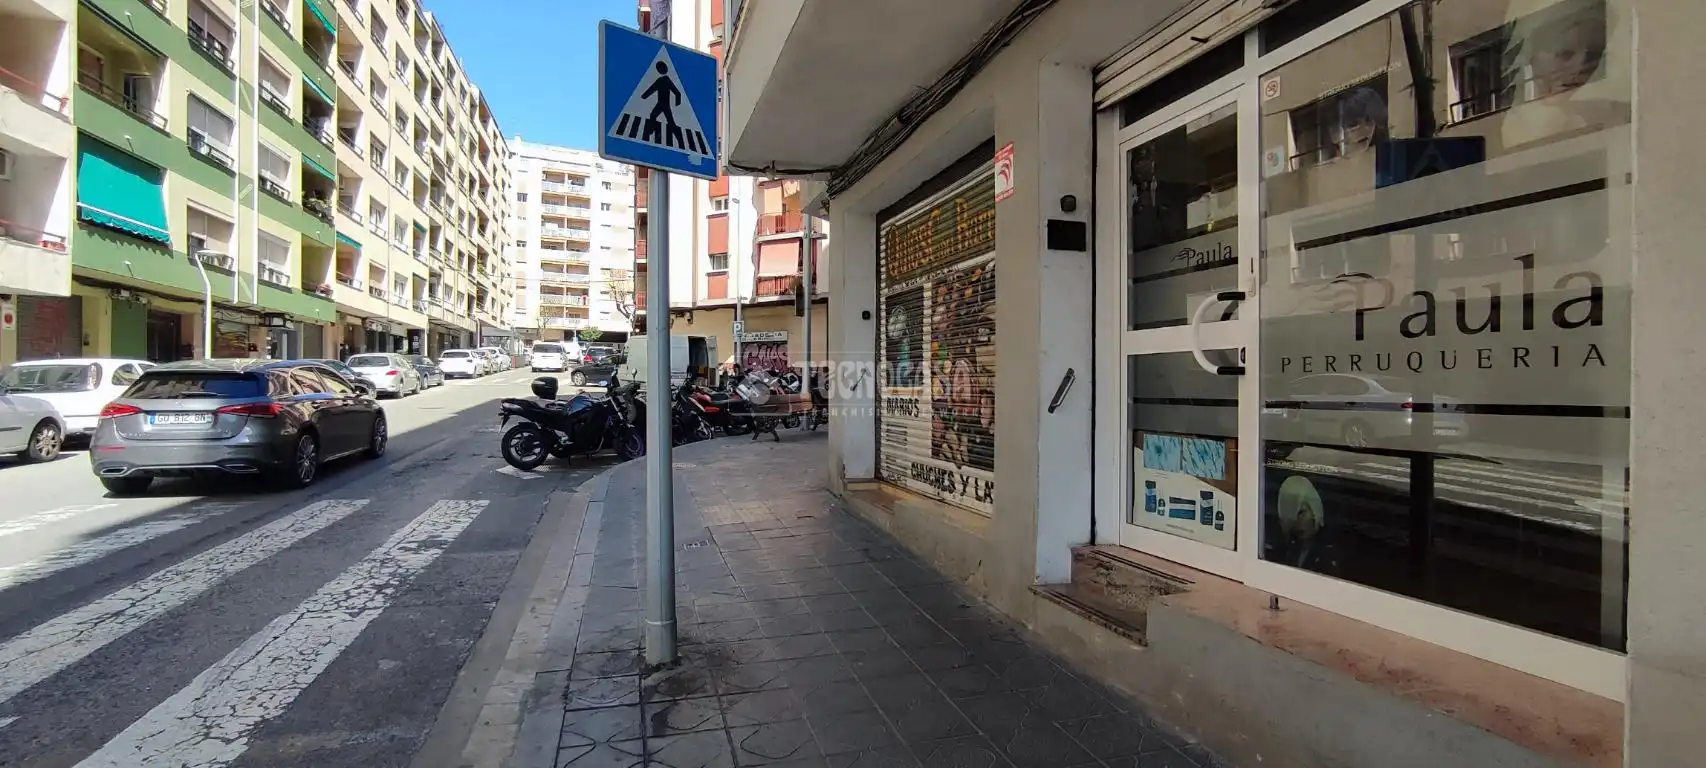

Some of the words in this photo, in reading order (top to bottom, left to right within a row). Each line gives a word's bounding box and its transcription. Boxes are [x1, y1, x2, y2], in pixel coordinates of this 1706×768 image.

[1182, 240, 1233, 267] Paula
[1350, 252, 1604, 342] Paula
[1281, 343, 1606, 374] PERRUQUERIA
[911, 461, 956, 494] CHUCHES
[960, 473, 970, 497] Y
